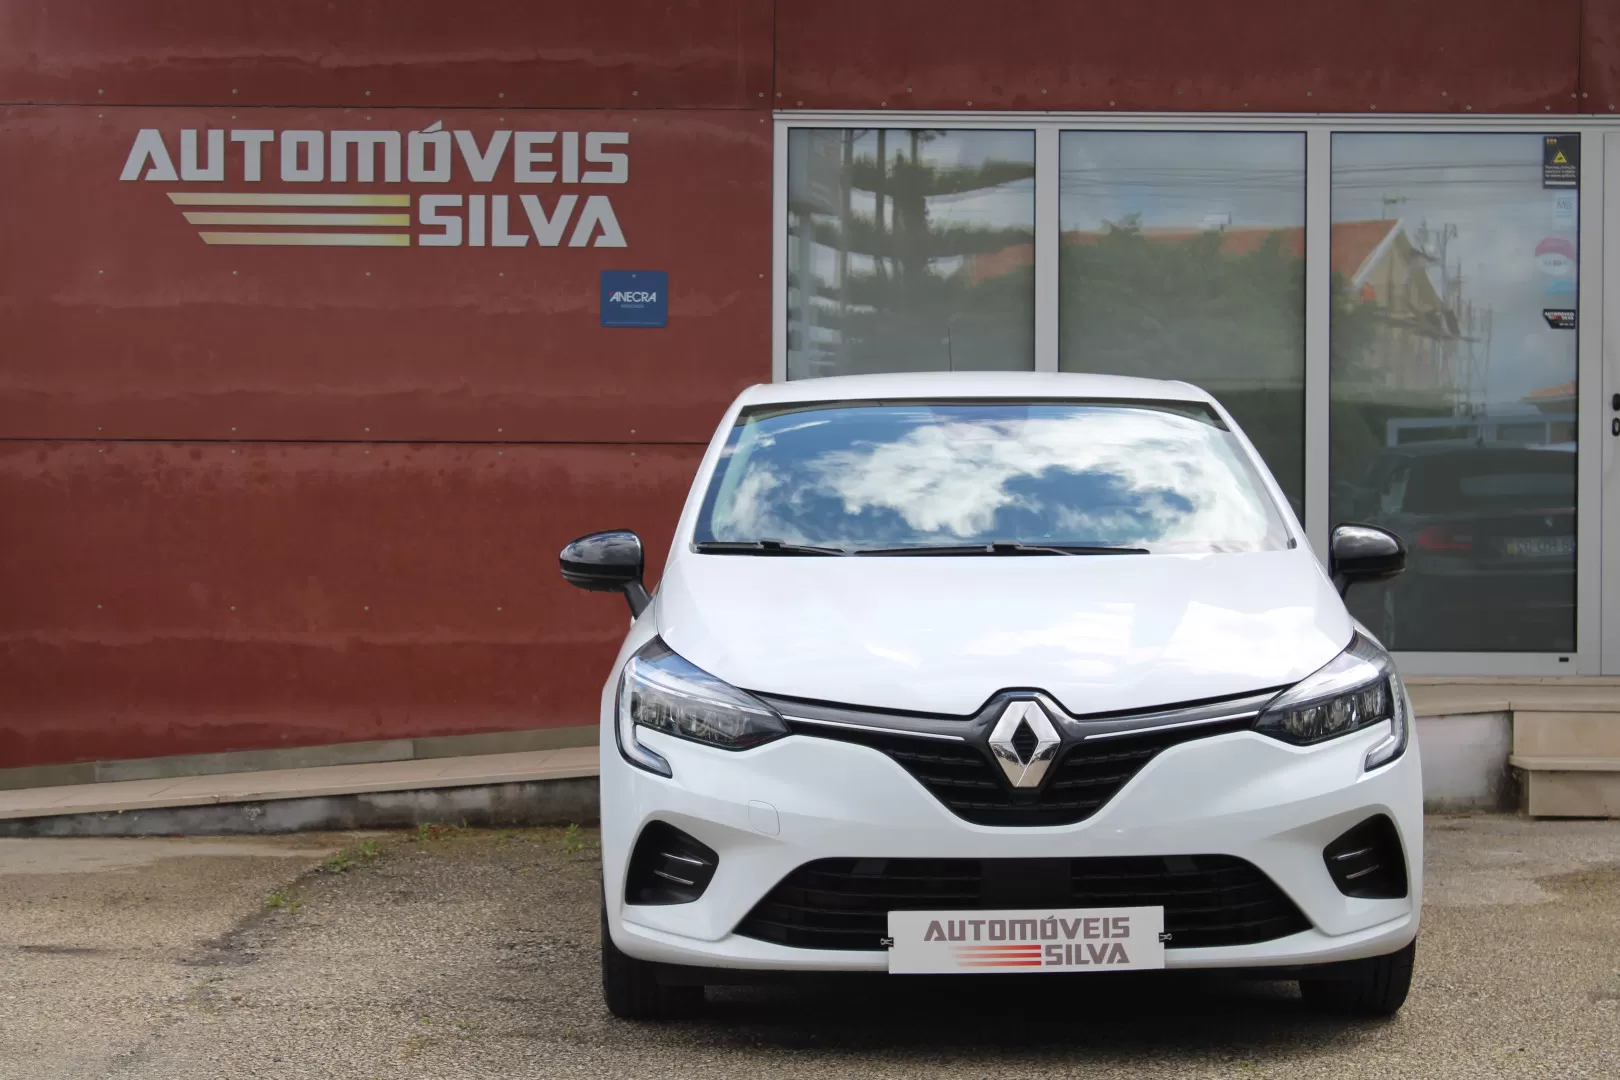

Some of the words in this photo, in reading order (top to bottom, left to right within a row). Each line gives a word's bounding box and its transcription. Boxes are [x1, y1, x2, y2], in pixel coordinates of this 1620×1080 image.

[119, 120, 629, 184] AUTOMÓVEIS
[418, 194, 628, 248] SILVA
[609, 291, 657, 303] ANECRA
[924, 915, 1130, 942] AUTOMÓVEIS
[1045, 943, 1131, 966] SILVA
